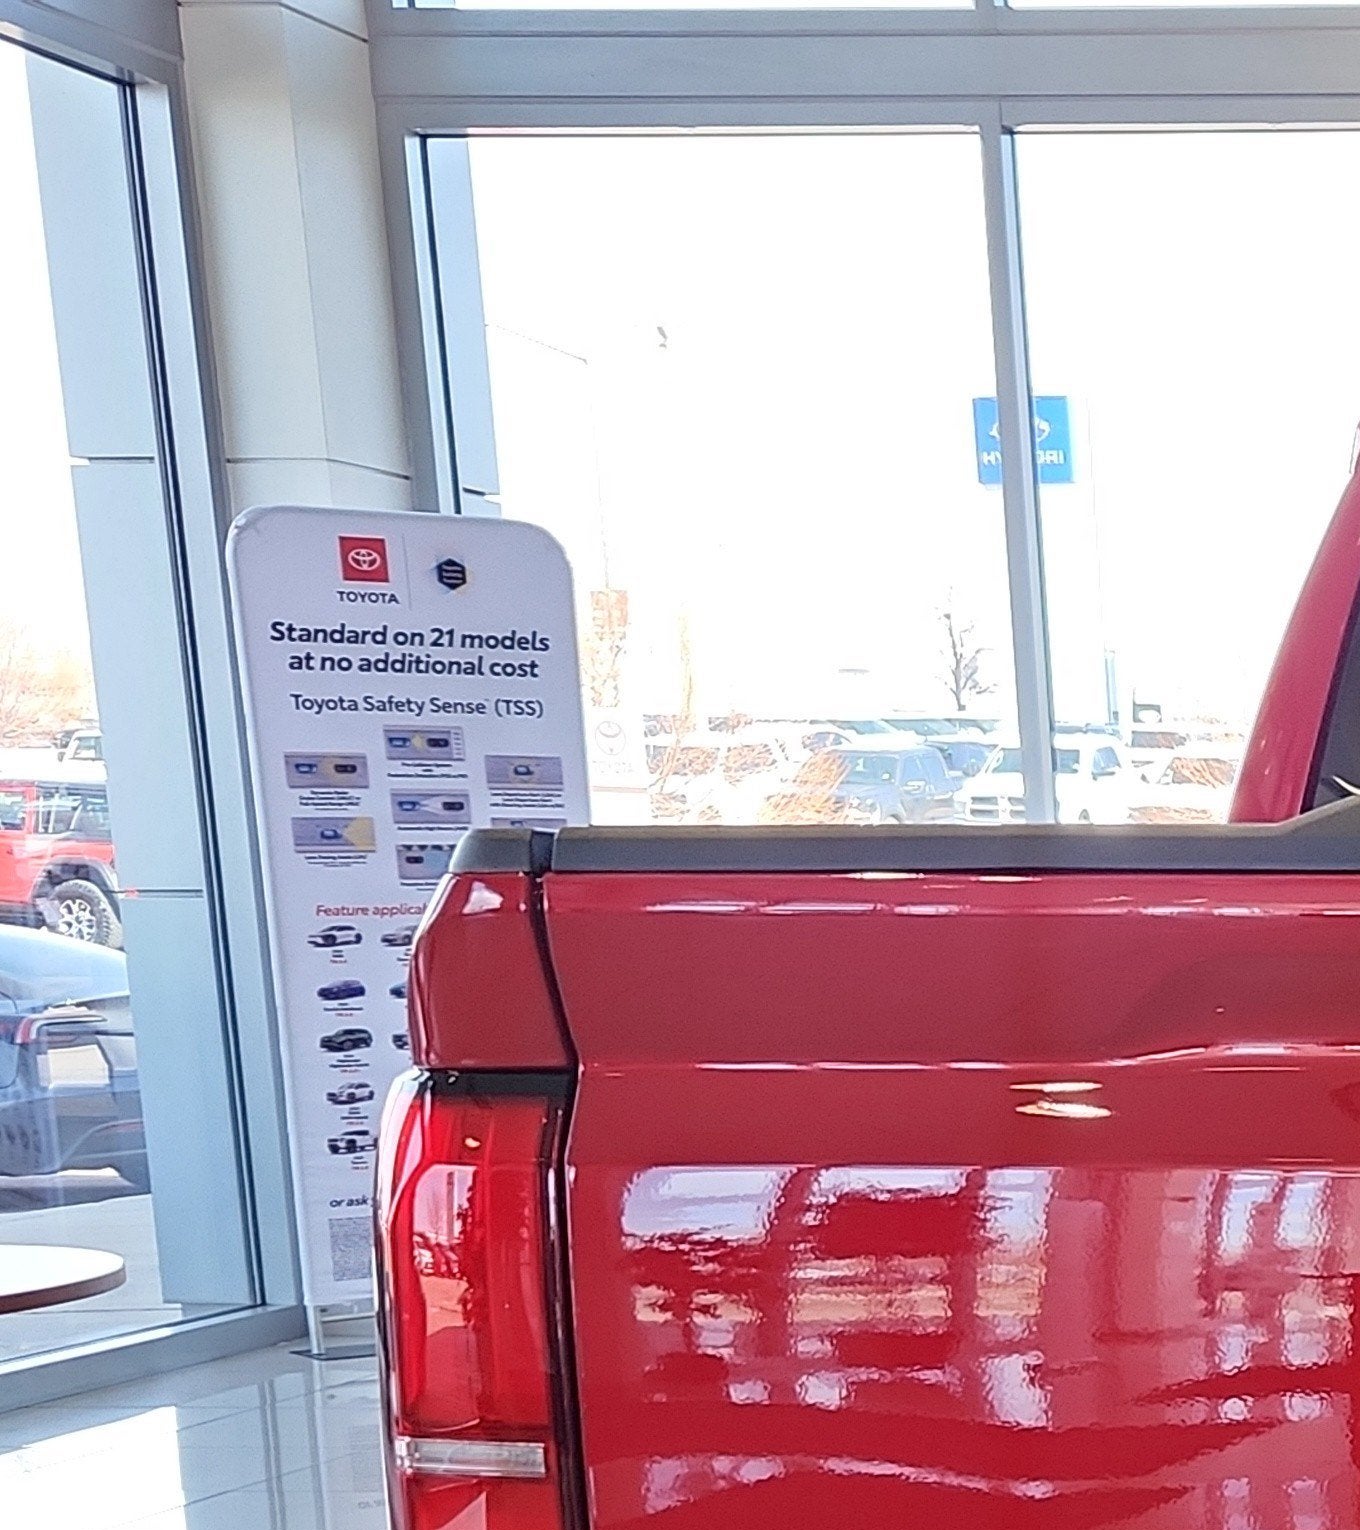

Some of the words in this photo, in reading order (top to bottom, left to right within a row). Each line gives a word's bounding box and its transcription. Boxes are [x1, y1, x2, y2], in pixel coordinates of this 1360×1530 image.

[337, 590, 400, 605] TOYOTA
[270, 621, 388, 646] Standard
[393, 631, 425, 647] on
[429, 628, 455, 648] 21
[460, 630, 550, 652] models
[288, 652, 315, 671] at
[320, 655, 353, 672] no
[357, 652, 484, 676] additional
[488, 660, 539, 678] cost
[290, 693, 359, 715] Toyota
[363, 695, 425, 717] Safety
[494, 698, 544, 718] (TSS)
[316, 905, 369, 916] Feature
[329, 1199, 344, 1208] or
[346, 1194, 369, 1207] ask
